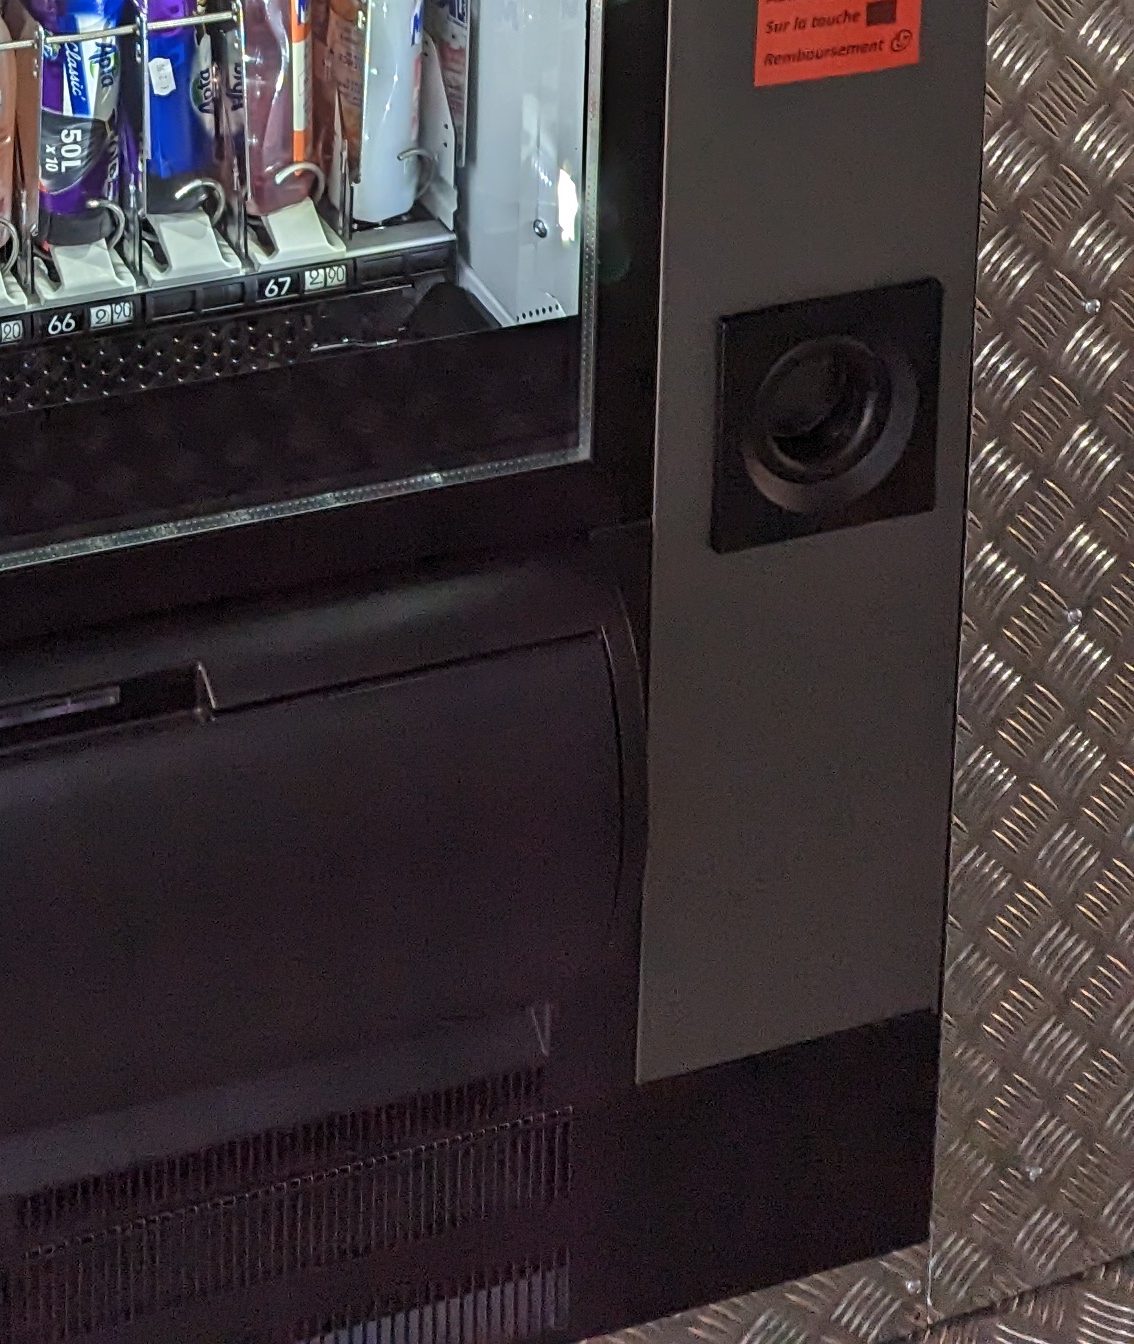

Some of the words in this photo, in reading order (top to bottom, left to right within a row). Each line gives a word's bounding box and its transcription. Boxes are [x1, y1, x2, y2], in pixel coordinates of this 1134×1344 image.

[766, 20, 789, 34] Sur
[793, 16, 807, 30] la
[811, 9, 861, 28] touche
[88, 41, 115, 88] Apta
[763, 39, 884, 66] Remboursement
[61, 129, 83, 173] 50L
[265, 277, 291, 297] 67
